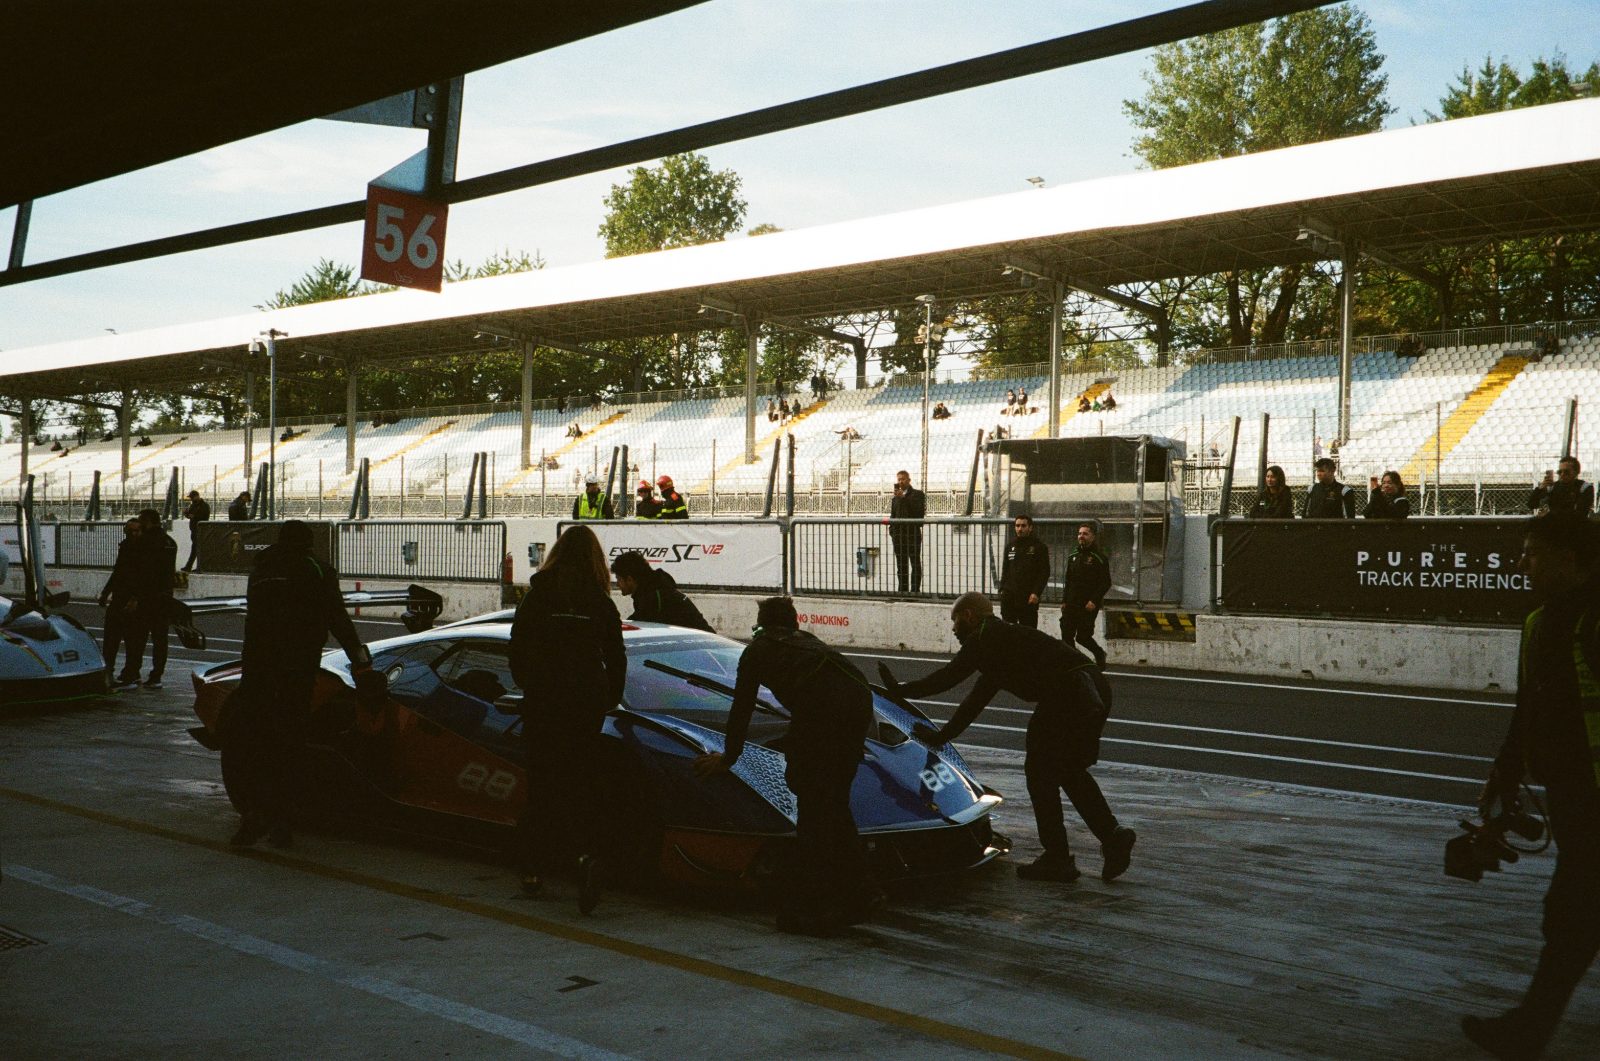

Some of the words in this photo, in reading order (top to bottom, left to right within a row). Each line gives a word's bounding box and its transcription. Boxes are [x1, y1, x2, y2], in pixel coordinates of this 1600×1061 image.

[374, 203, 438, 270] 56
[701, 544, 725, 555] V12
[1430, 544, 1456, 553] THE
[1357, 570, 1414, 587] TRACK
[1420, 572, 1533, 591] EXPERIENCE
[797, 613, 808, 623] NO
[810, 614, 849, 626] SMOKING
[52, 649, 81, 664] 19
[457, 763, 517, 799] 88
[919, 763, 956, 792] 88
